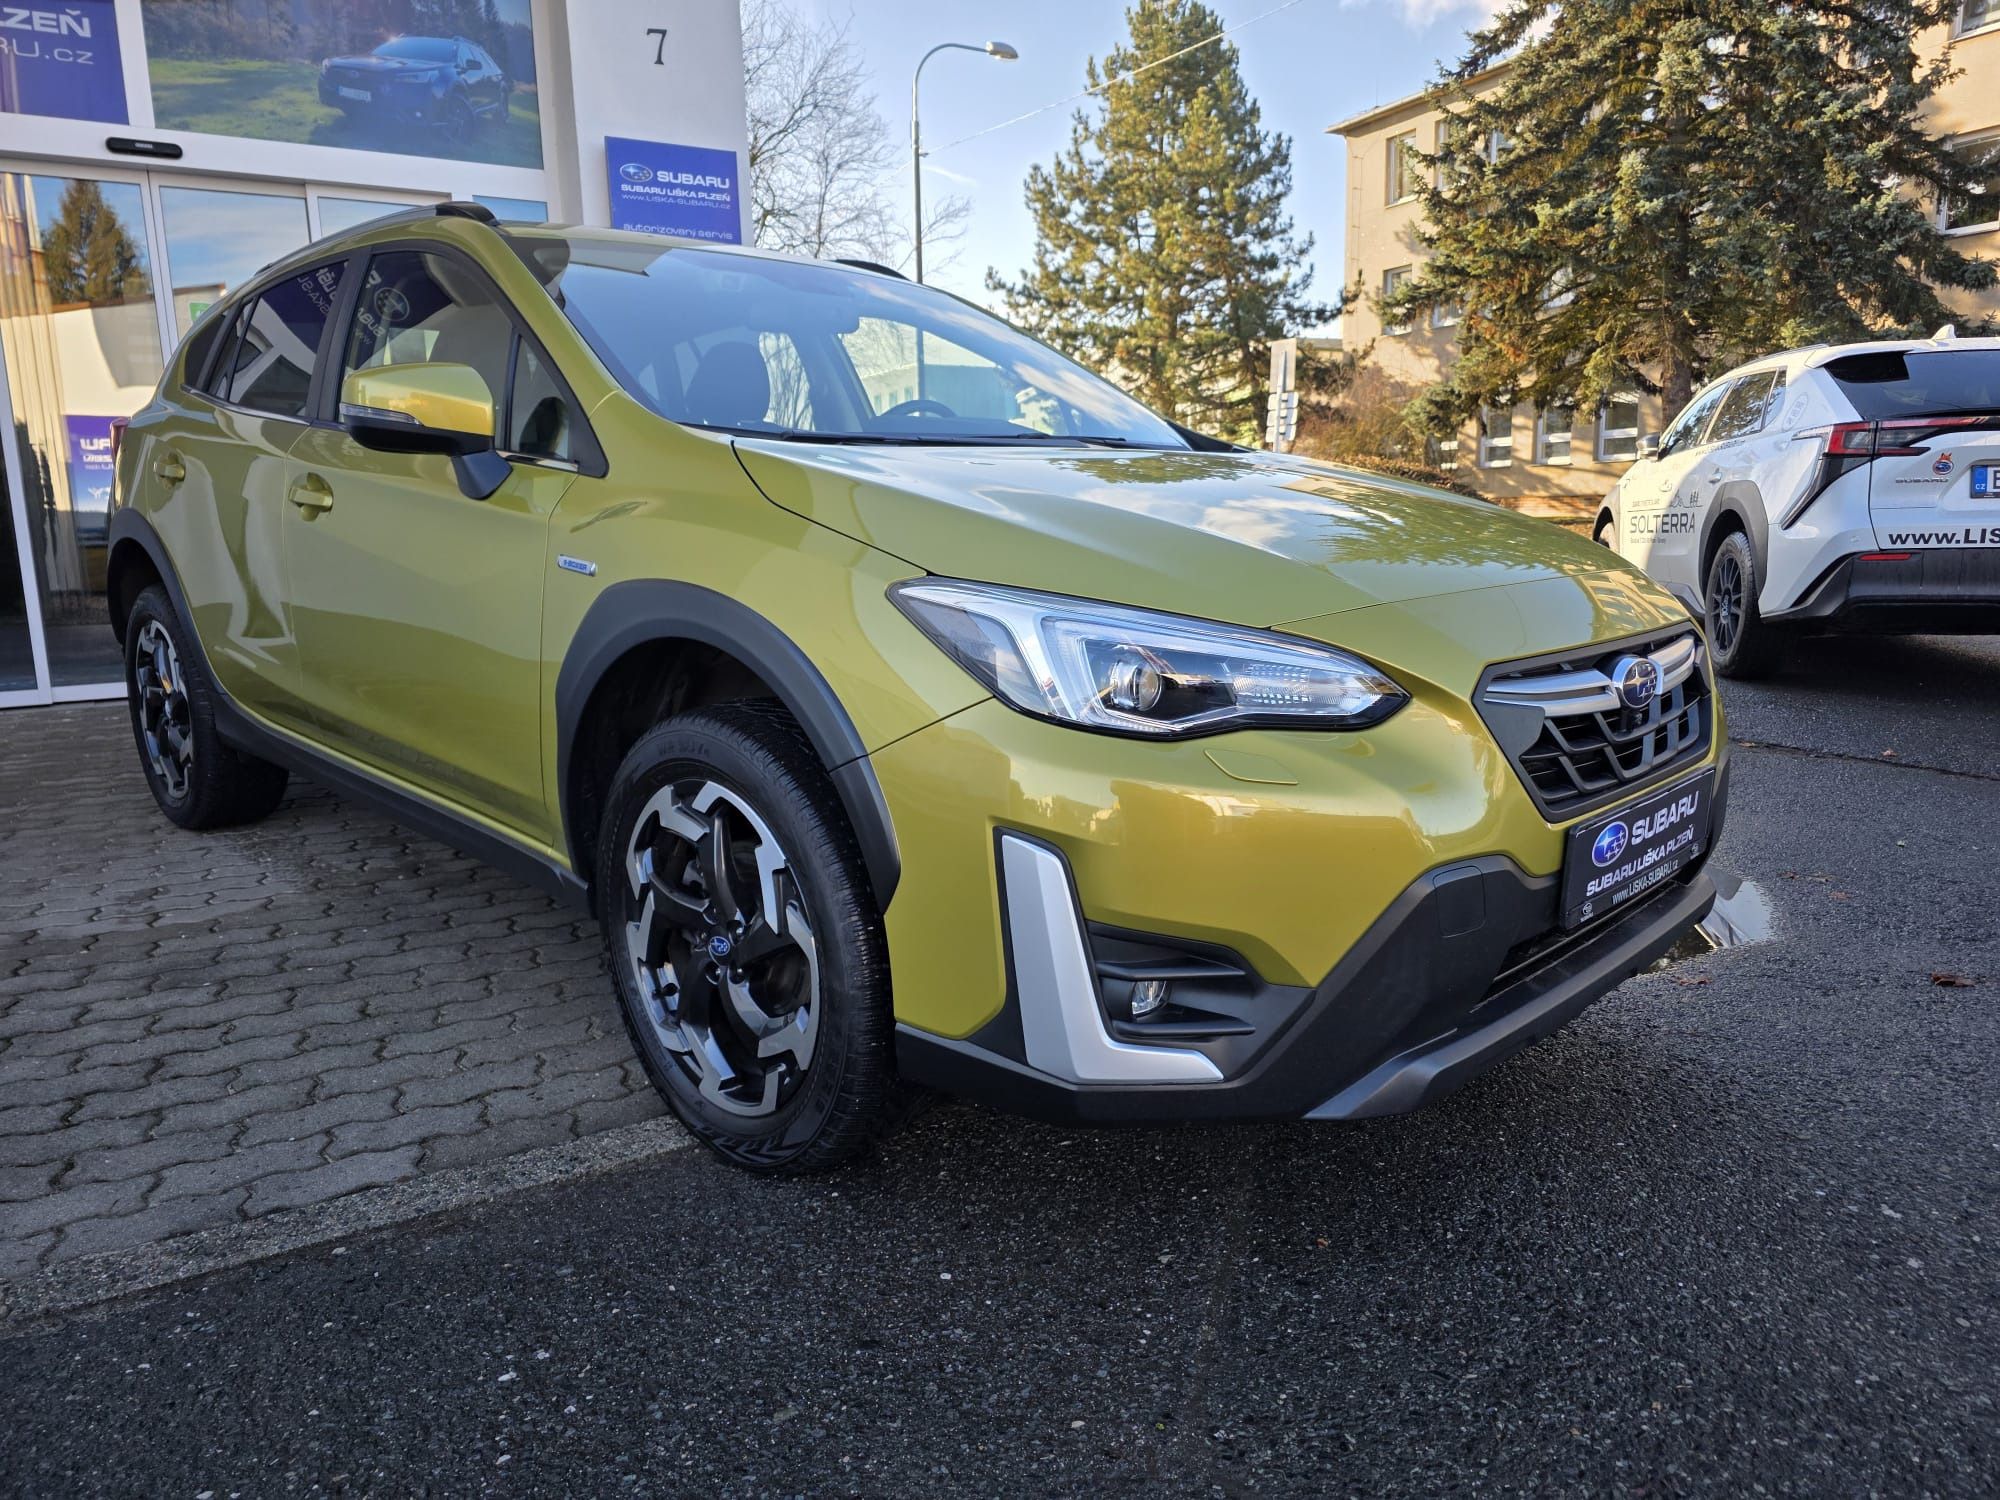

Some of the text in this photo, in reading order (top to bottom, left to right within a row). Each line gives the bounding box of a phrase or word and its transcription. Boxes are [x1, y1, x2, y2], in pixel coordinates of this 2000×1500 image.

[646, 28, 667, 65] 7
[621, 184, 731, 202] SUBARU LIŠKA PLZEŇ
[656, 170, 730, 189] SUBARU
[698, 229, 733, 240] servis
[1630, 512, 1696, 534] SOLTERRA
[1631, 791, 1699, 846] SUBARU
[1586, 823, 1694, 897] SUBARU LIŠKA PLZEŇ
[1612, 859, 1679, 905] www.LISKA-SUBARU.cz
